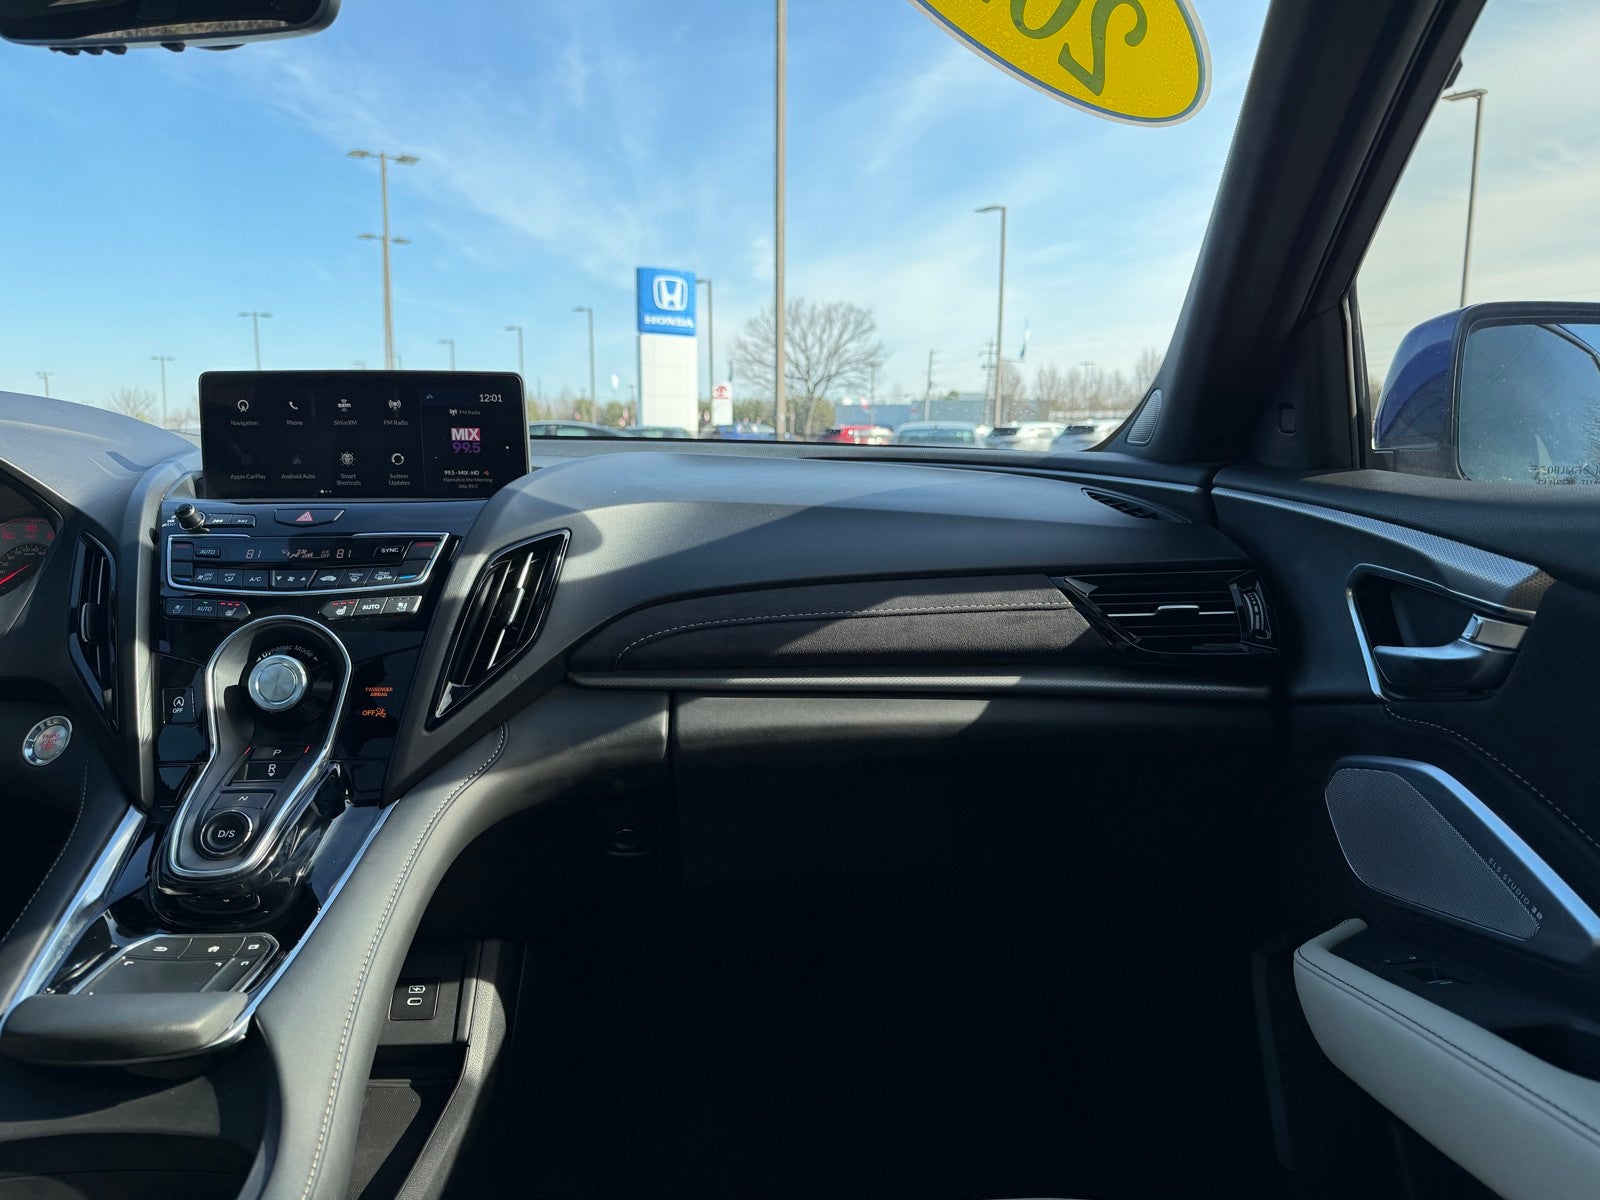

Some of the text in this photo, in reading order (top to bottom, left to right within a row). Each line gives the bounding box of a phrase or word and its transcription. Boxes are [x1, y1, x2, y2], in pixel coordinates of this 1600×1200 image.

[644, 314, 694, 328] HONDA
[479, 393, 503, 403] 12:01
[451, 428, 480, 441] MIX
[452, 442, 481, 454] 99.5
[1547, 465, 1590, 475] OBJECTS
[230, 473, 267, 481] Apple CarPlay
[389, 473, 408, 481] System
[246, 549, 262, 559] 81
[336, 549, 352, 559] 81
[196, 605, 213, 613] AUTO
[363, 603, 380, 611] AUTO
[262, 644, 315, 659] Dynamic Mode
[272, 749, 282, 757] P
[267, 764, 277, 773] R
[217, 829, 236, 839] D/S
[1488, 857, 1502, 873] ELS
[1502, 874, 1530, 905] STUDIO
